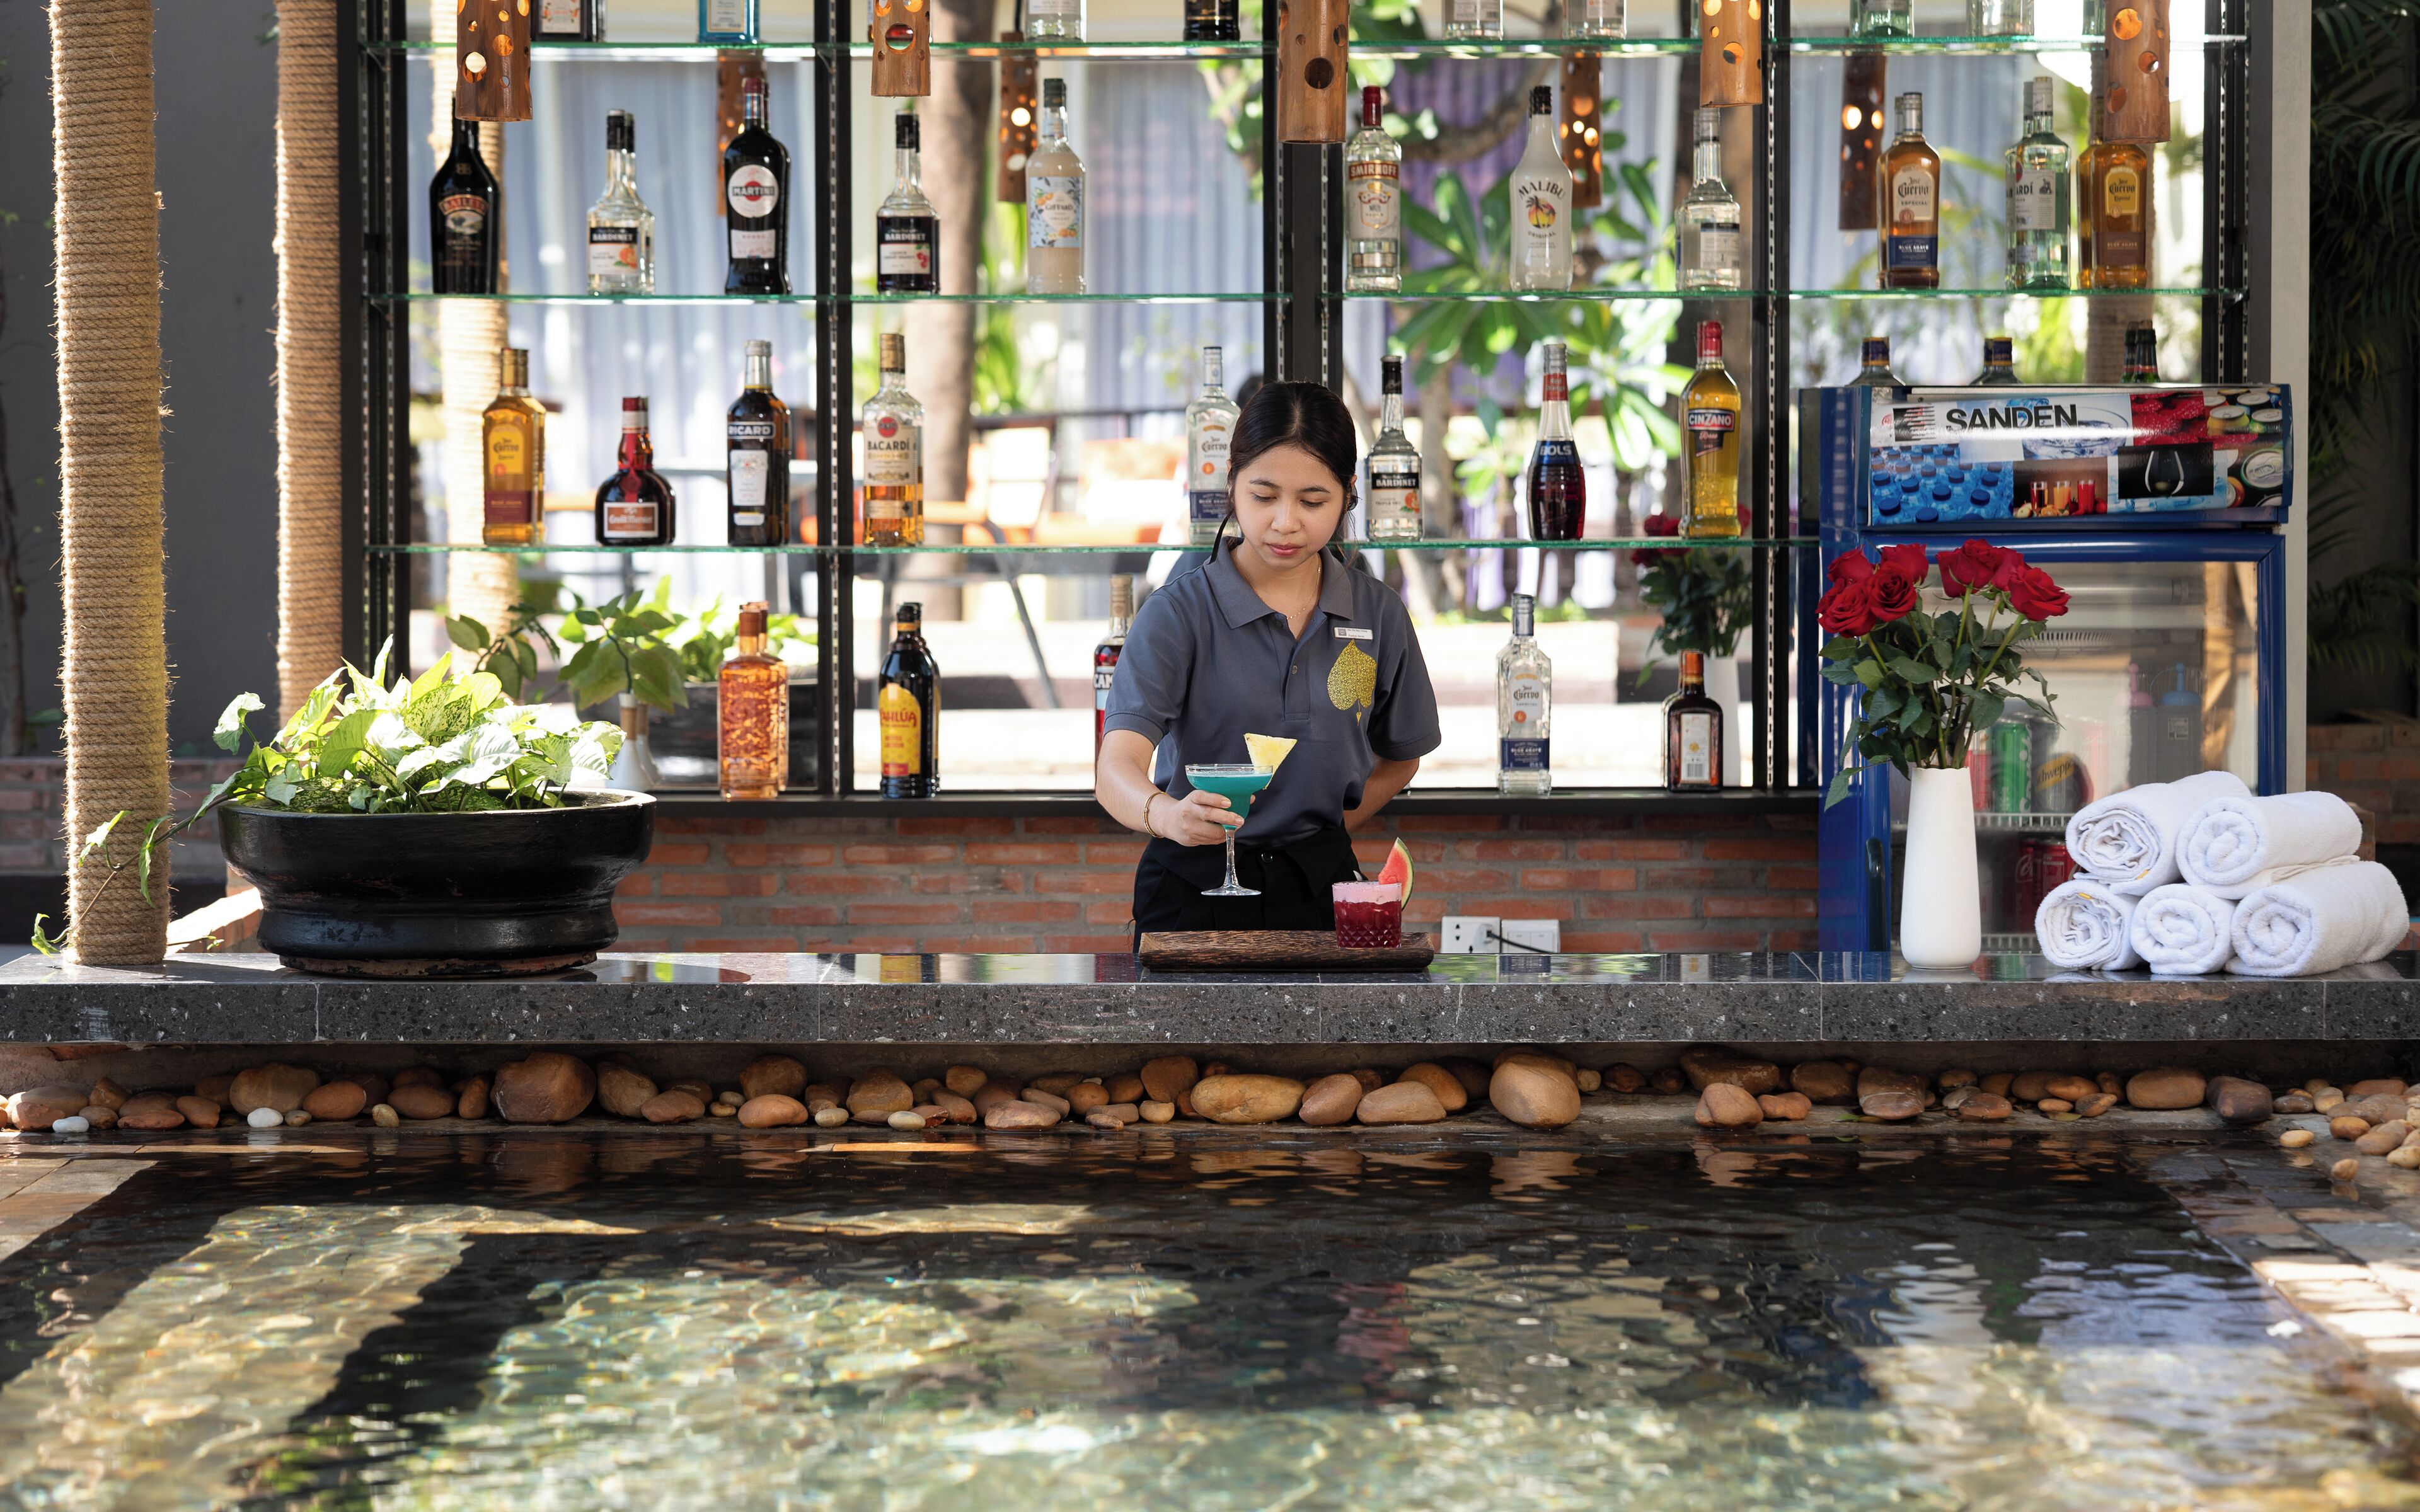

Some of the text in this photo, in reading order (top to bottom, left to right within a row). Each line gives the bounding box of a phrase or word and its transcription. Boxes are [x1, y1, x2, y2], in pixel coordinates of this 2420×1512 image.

[1351, 163, 1397, 177] SMIRNOFF
[733, 186, 775, 196] MARTINI
[1519, 181, 1566, 200] MALIBU
[1898, 182, 1929, 198] Cuervo
[2109, 183, 2135, 194] Cuervo
[1689, 413, 1732, 427] CINZANO
[1945, 404, 2078, 430] SANDEN
[729, 426, 771, 435] RICARD
[868, 438, 909, 450] BACARDÍ
[1540, 445, 1572, 455] BOLS
[1376, 479, 1416, 487] BARDINET
[1514, 689, 1539, 701] Cuervo
